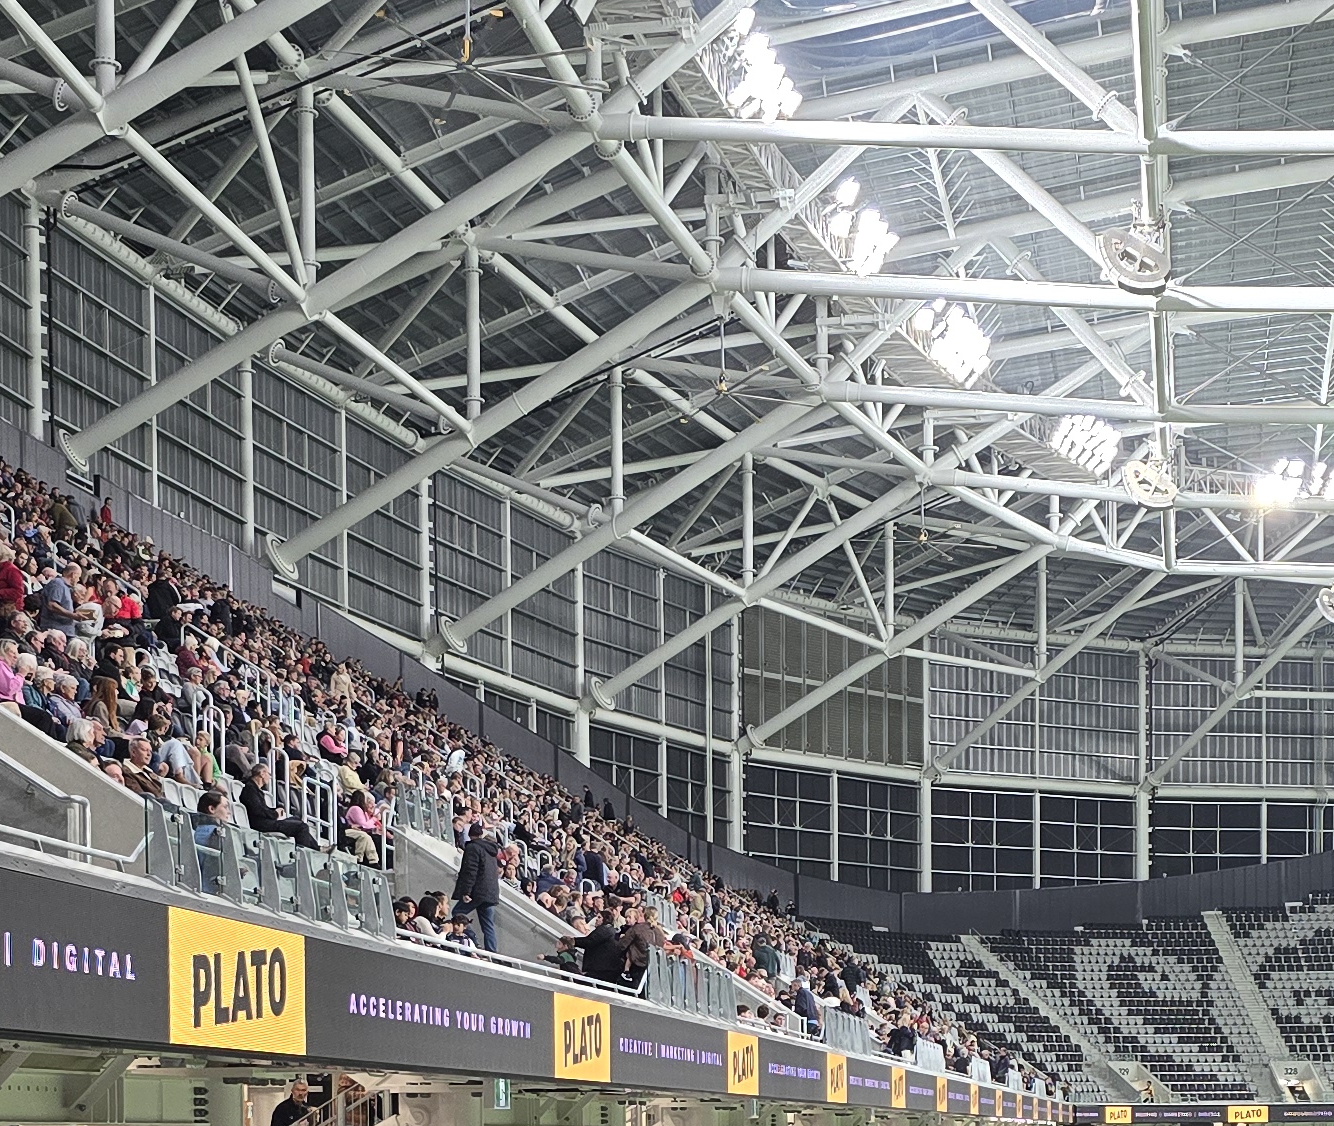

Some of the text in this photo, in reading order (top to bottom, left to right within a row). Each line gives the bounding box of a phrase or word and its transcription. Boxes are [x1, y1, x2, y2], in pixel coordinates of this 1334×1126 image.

[31, 938, 136, 981] DIGITAL
[191, 946, 287, 1029] PLATO
[349, 993, 531, 1039] ACCELERATING YOUR GROWTH
[563, 1012, 602, 1068] PLATO
[619, 1037, 653, 1057] CREATIVE
[660, 1044, 696, 1063] MARKETING
[701, 1051, 724, 1067] DIGITAL
[732, 1043, 755, 1085] PLATO
[1284, 1067, 1298, 1076] 328
[1109, 1109, 1128, 1121] PLATO
[1234, 1108, 1262, 1120] PLATO
